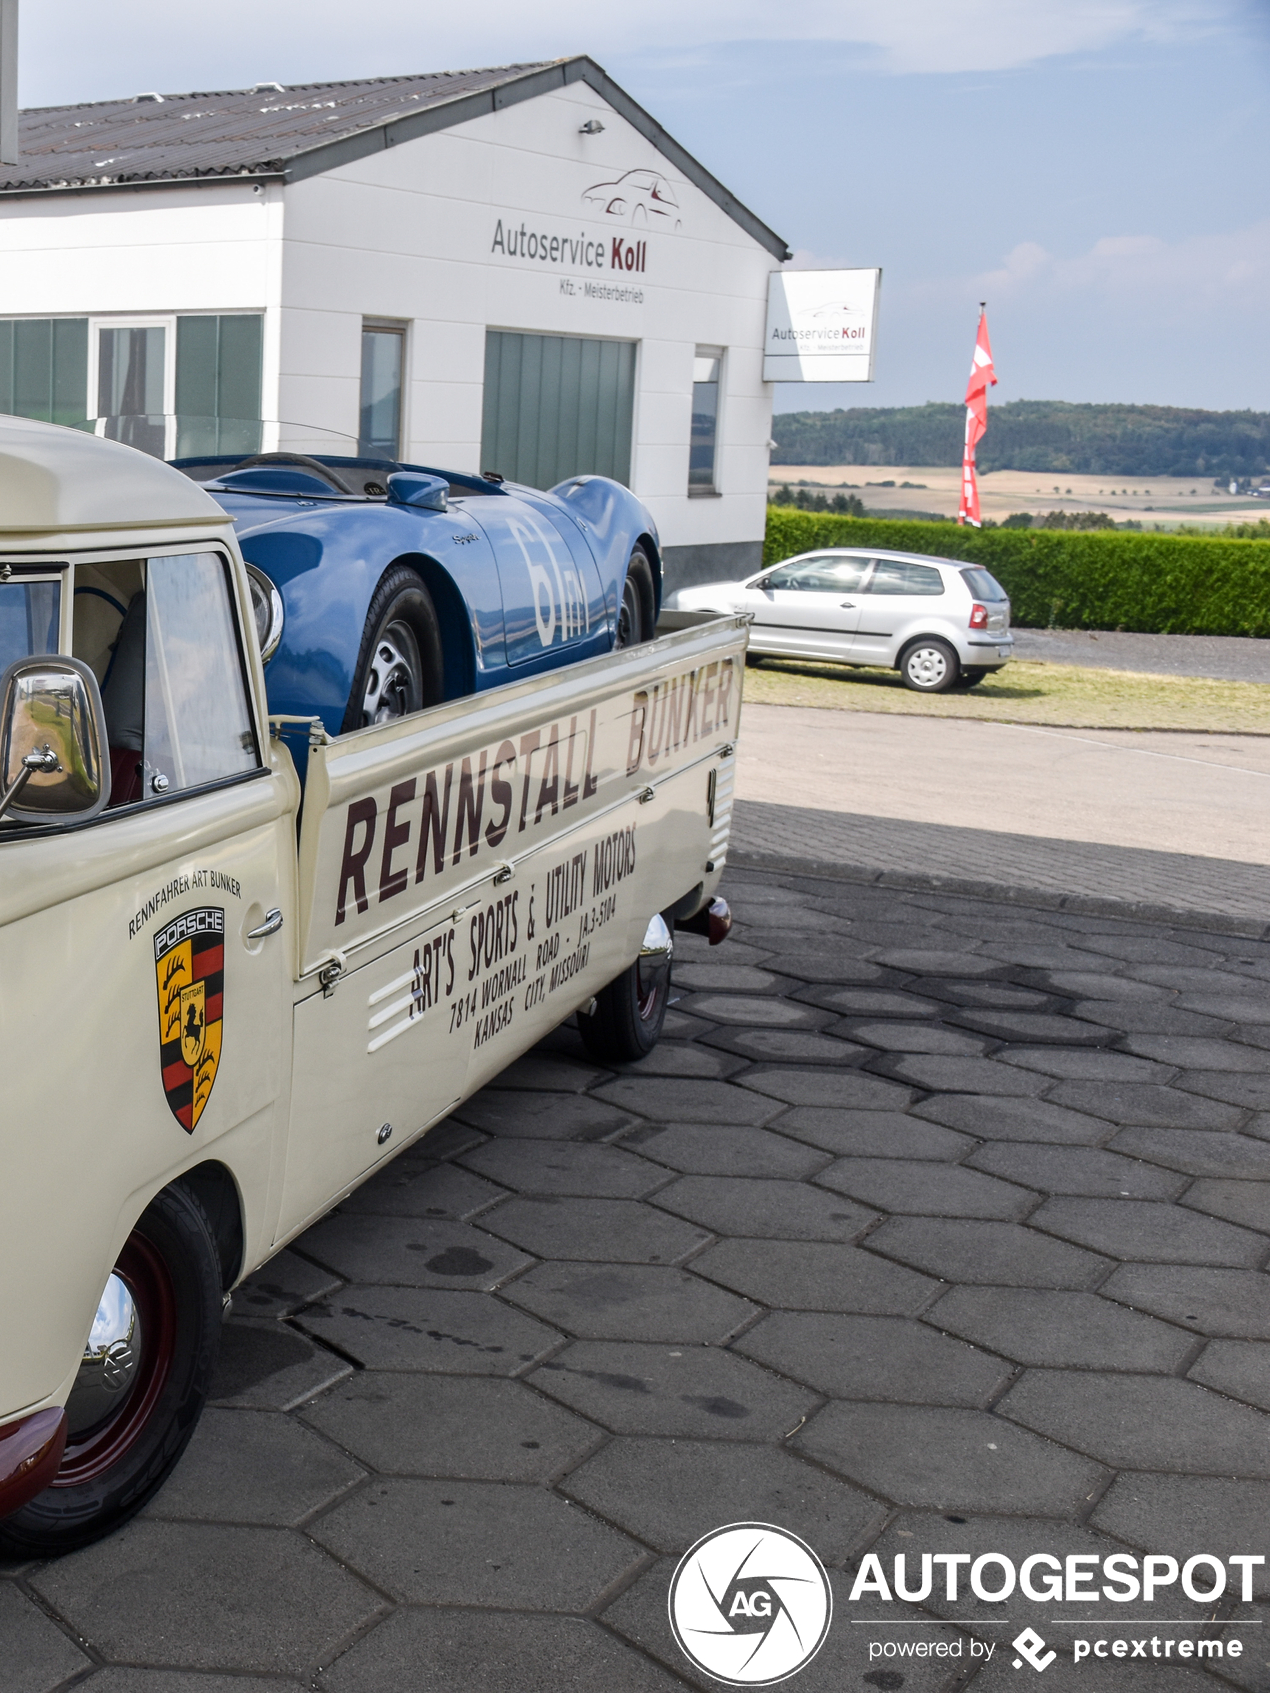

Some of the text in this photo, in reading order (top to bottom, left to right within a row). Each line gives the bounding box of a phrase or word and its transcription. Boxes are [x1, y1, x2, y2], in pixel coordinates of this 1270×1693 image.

[491, 219, 646, 273] Autoservice Koll
[559, 278, 576, 297] Kfz.
[584, 283, 644, 304] Meisterbetrieb
[772, 327, 865, 341] Autoservice Koll
[335, 656, 734, 926] RENNSTALL BUNKER
[128, 870, 242, 941] RENNFAHRER ART BUNKER
[468, 890, 519, 982] SPORTS
[545, 848, 587, 930] UTILITY
[592, 822, 637, 897] MOTORS
[156, 910, 223, 957] PORSCHE
[182, 985, 204, 1002] STUTTGART
[449, 992, 477, 1034] 7814
[480, 967, 527, 1020] WORNALL
[536, 936, 560, 973] ROAD
[473, 1003, 514, 1050] KANSAS
[549, 941, 590, 996] MISSOURI
